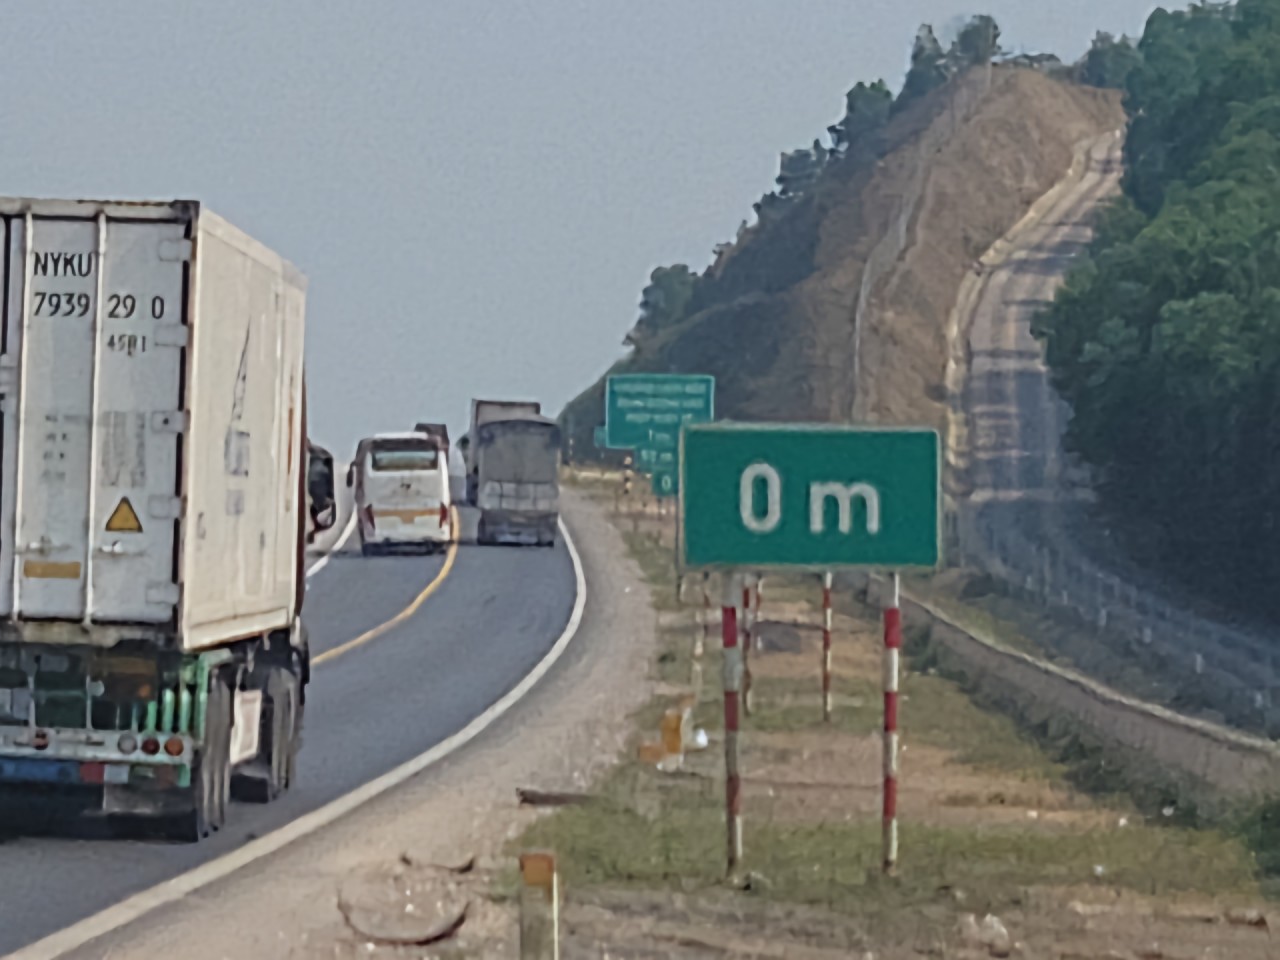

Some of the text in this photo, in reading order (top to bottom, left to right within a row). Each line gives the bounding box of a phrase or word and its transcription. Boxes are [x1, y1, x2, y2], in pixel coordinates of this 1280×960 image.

[33, 251, 93, 277] NYKU
[33, 292, 90, 318] 7939
[107, 294, 136, 319] 29
[739, 462, 881, 535] 0 m
